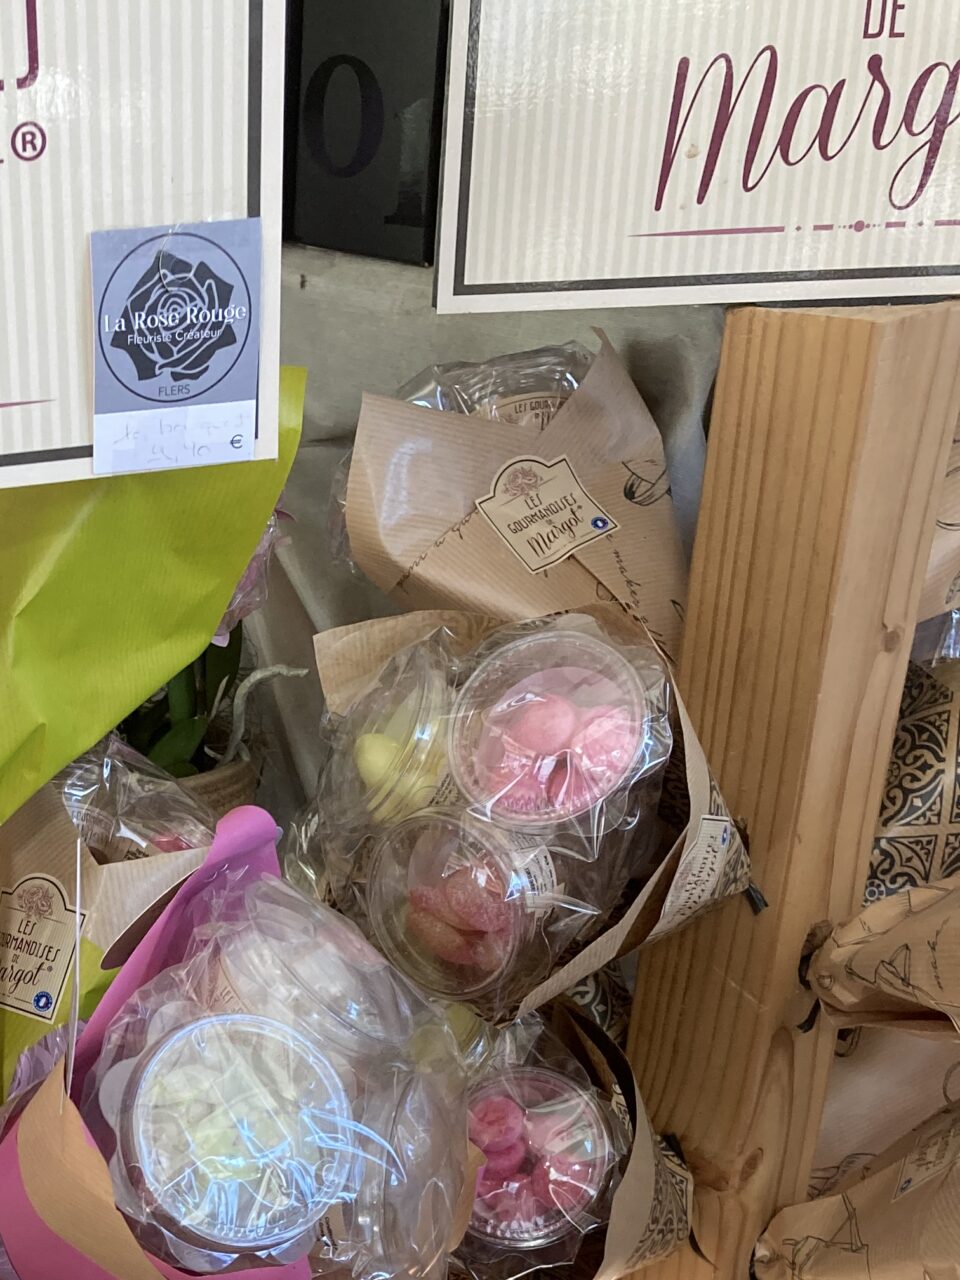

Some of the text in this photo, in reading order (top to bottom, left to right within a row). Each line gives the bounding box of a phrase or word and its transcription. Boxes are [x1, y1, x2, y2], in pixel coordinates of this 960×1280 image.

[654, 45, 960, 211] Marg
[104, 304, 248, 332] La Rose Rouge
[127, 327, 222, 346] Fleuriste Créateur
[158, 384, 191, 398] FLERS
[507, 492, 577, 534] GOURMANDISES
[524, 493, 543, 510] LES
[526, 508, 585, 558] Margot
[18, 918, 37, 936] LES
